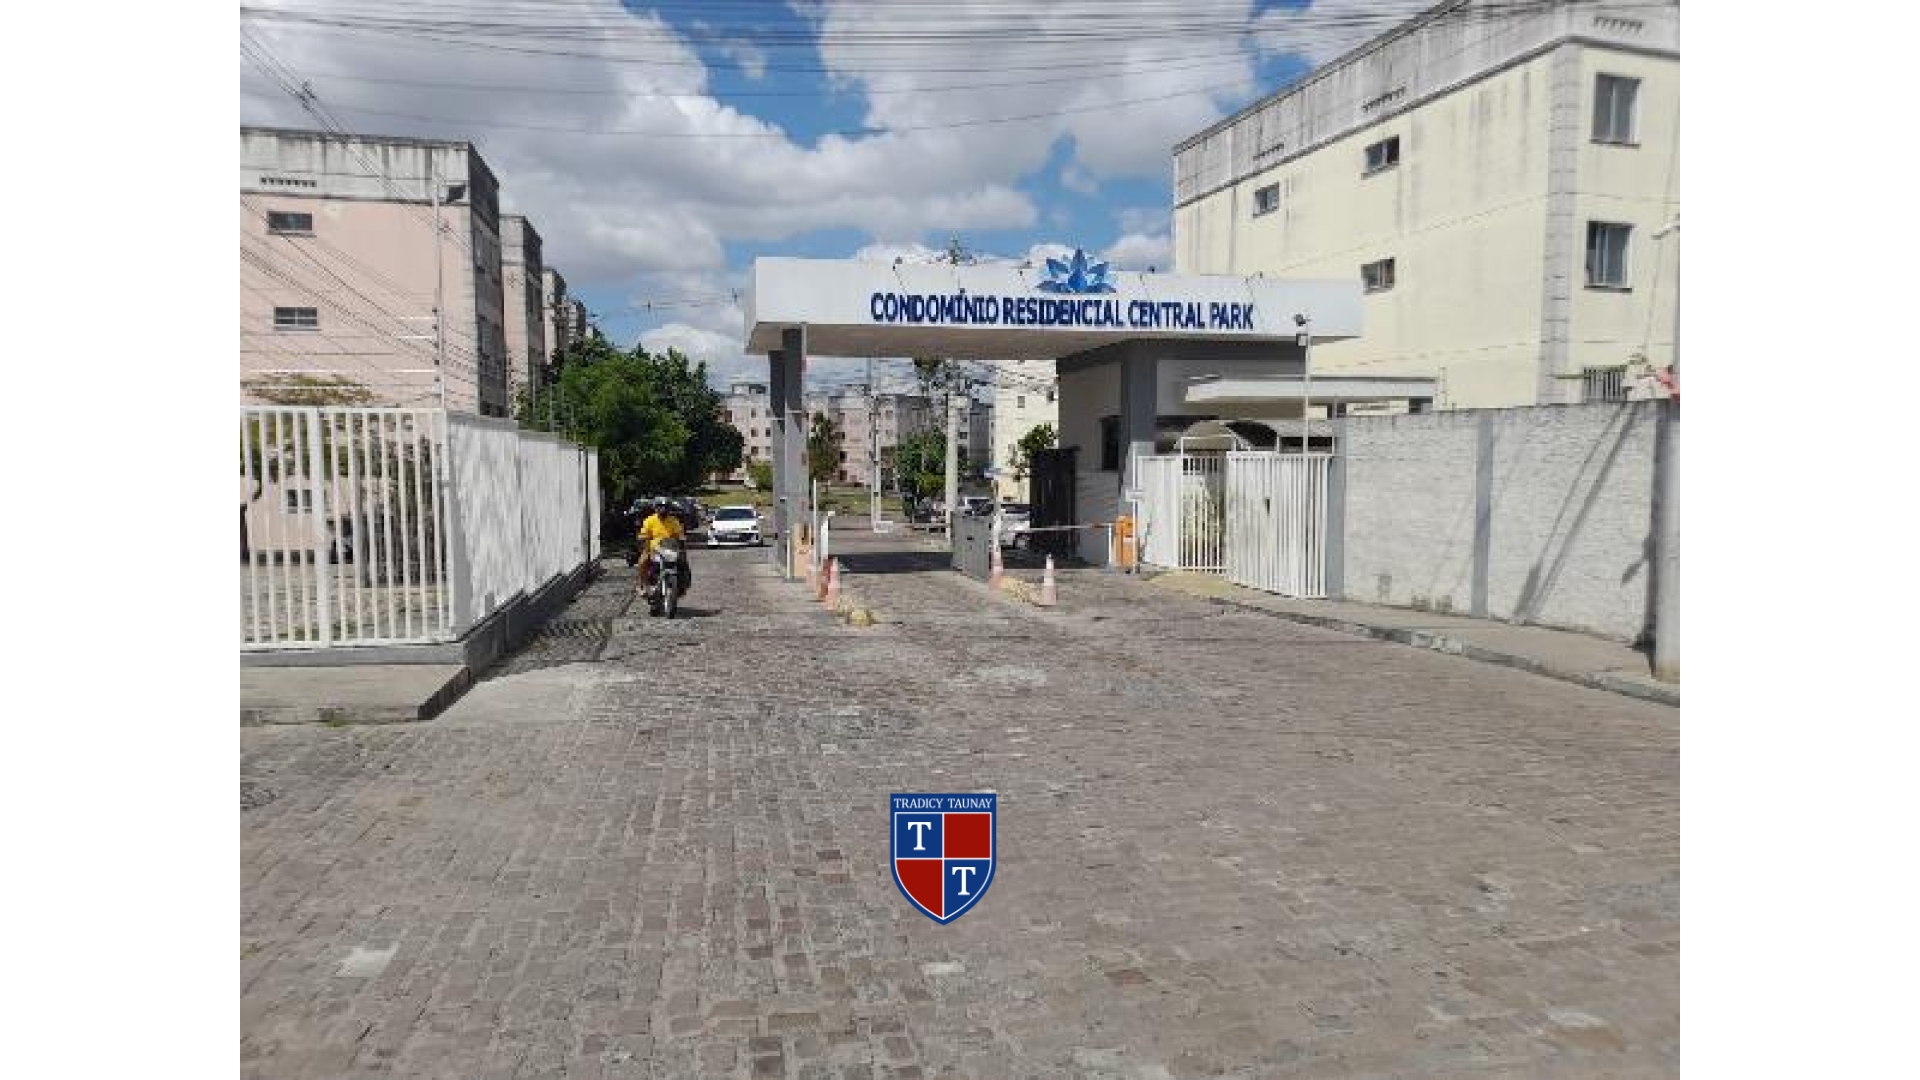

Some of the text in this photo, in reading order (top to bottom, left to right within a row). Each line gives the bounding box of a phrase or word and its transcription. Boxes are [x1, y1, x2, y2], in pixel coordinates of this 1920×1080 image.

[870, 291, 1254, 330] CONDOMÍNIO RESIDENCIAL CENTRAL PARK
